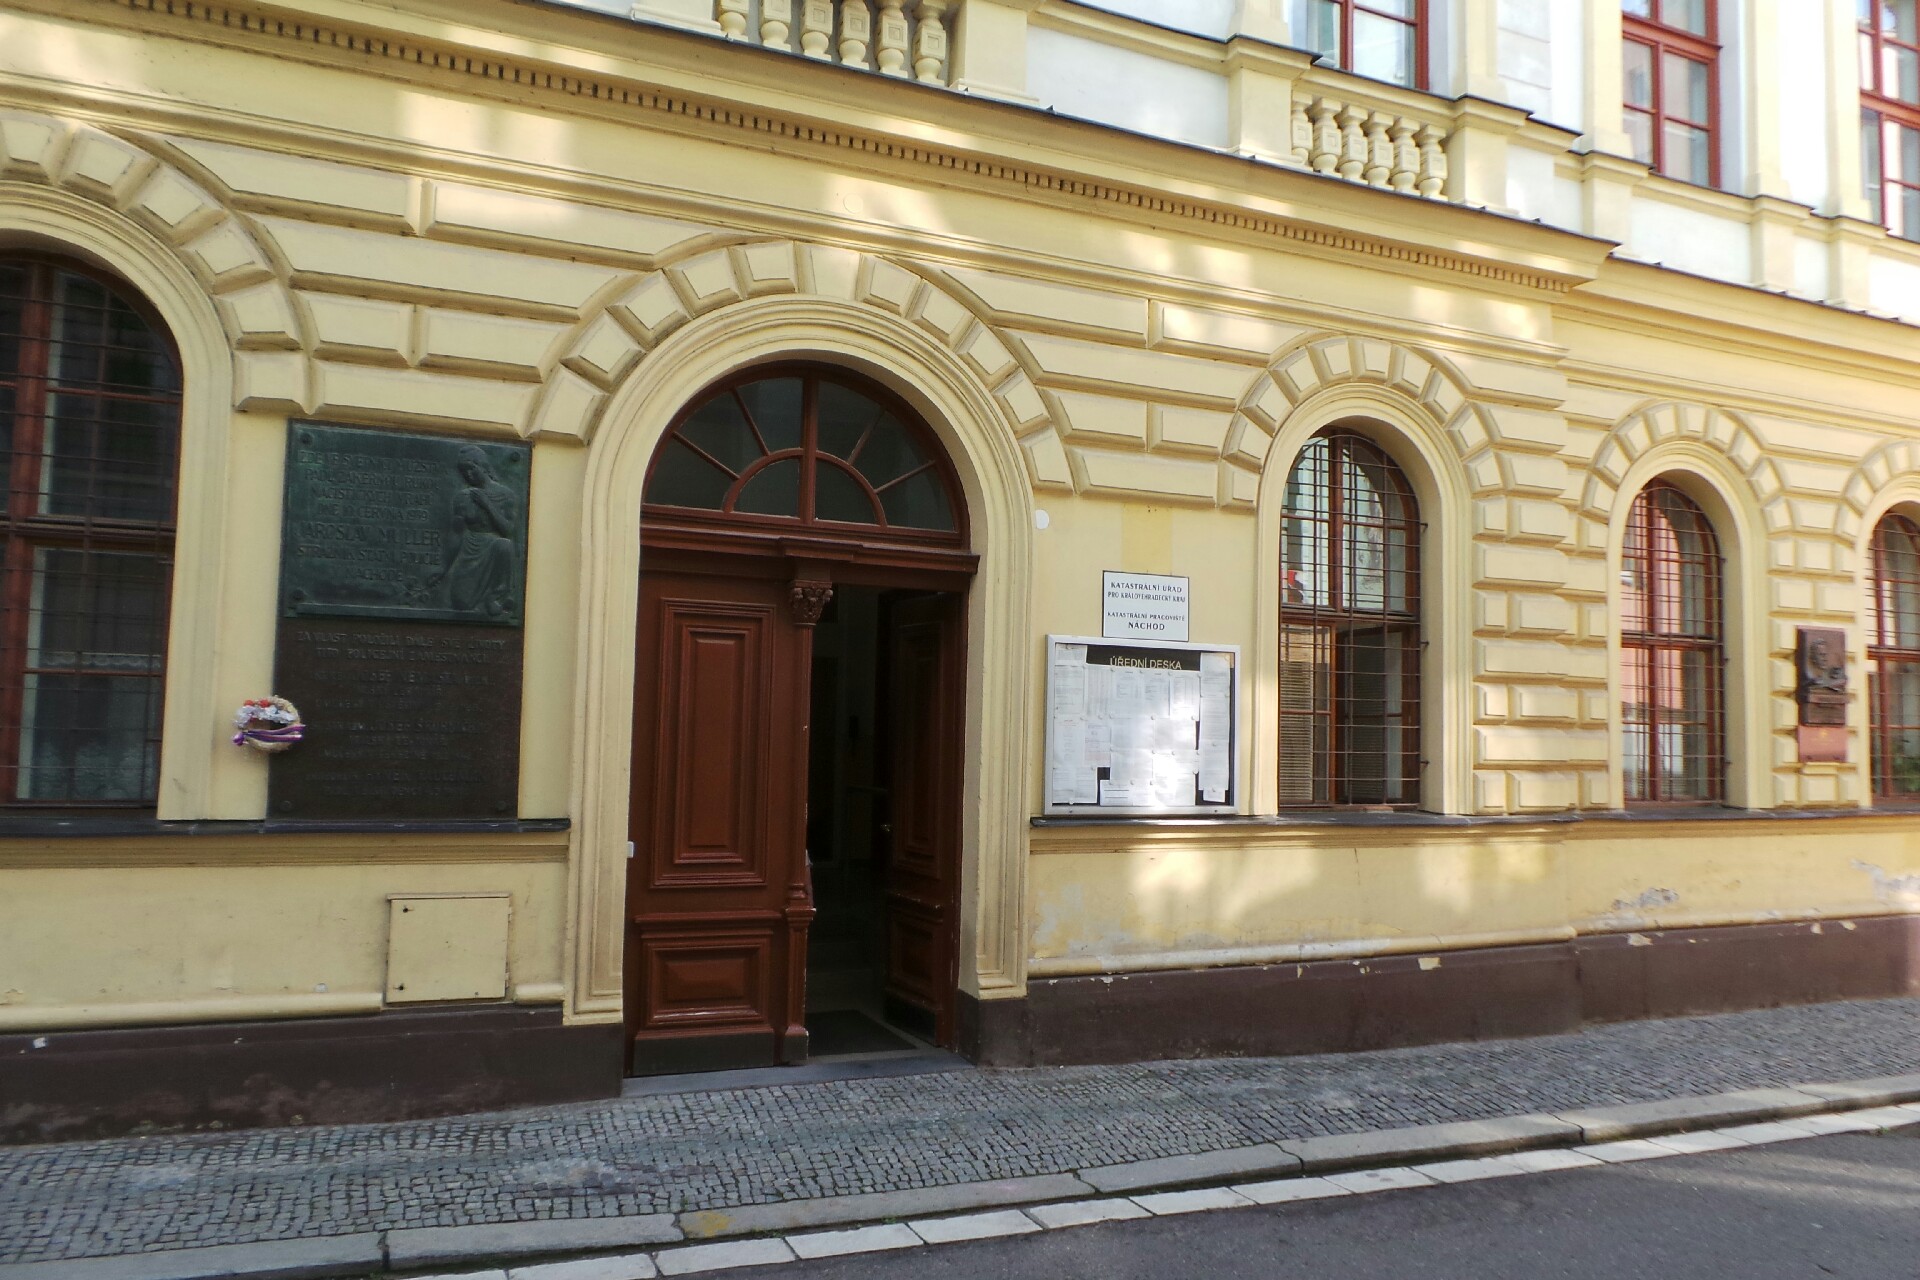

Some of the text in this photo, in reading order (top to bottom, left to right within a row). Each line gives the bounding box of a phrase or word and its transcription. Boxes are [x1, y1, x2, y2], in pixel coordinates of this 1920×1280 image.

[1128, 620, 1165, 630] NÁCHOD
[1110, 656, 1182, 670] ÚŘEDNÍ DESKA
